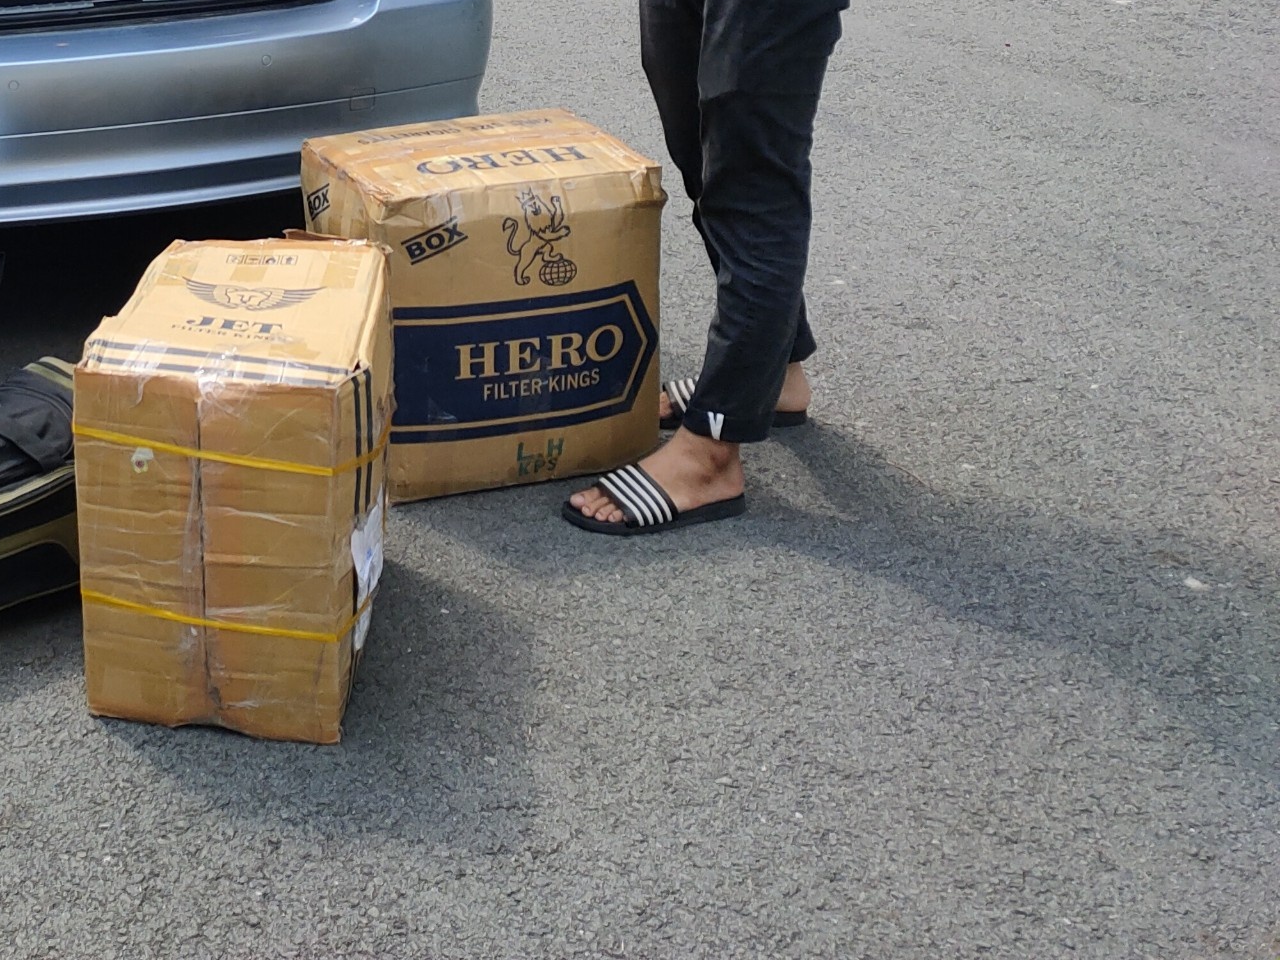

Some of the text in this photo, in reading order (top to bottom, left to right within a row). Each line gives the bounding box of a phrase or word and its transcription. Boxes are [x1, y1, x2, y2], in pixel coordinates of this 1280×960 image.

[416, 145, 594, 175] HERO
[405, 222, 464, 260] BOX
[186, 316, 282, 334] JET
[454, 324, 624, 380] HERO
